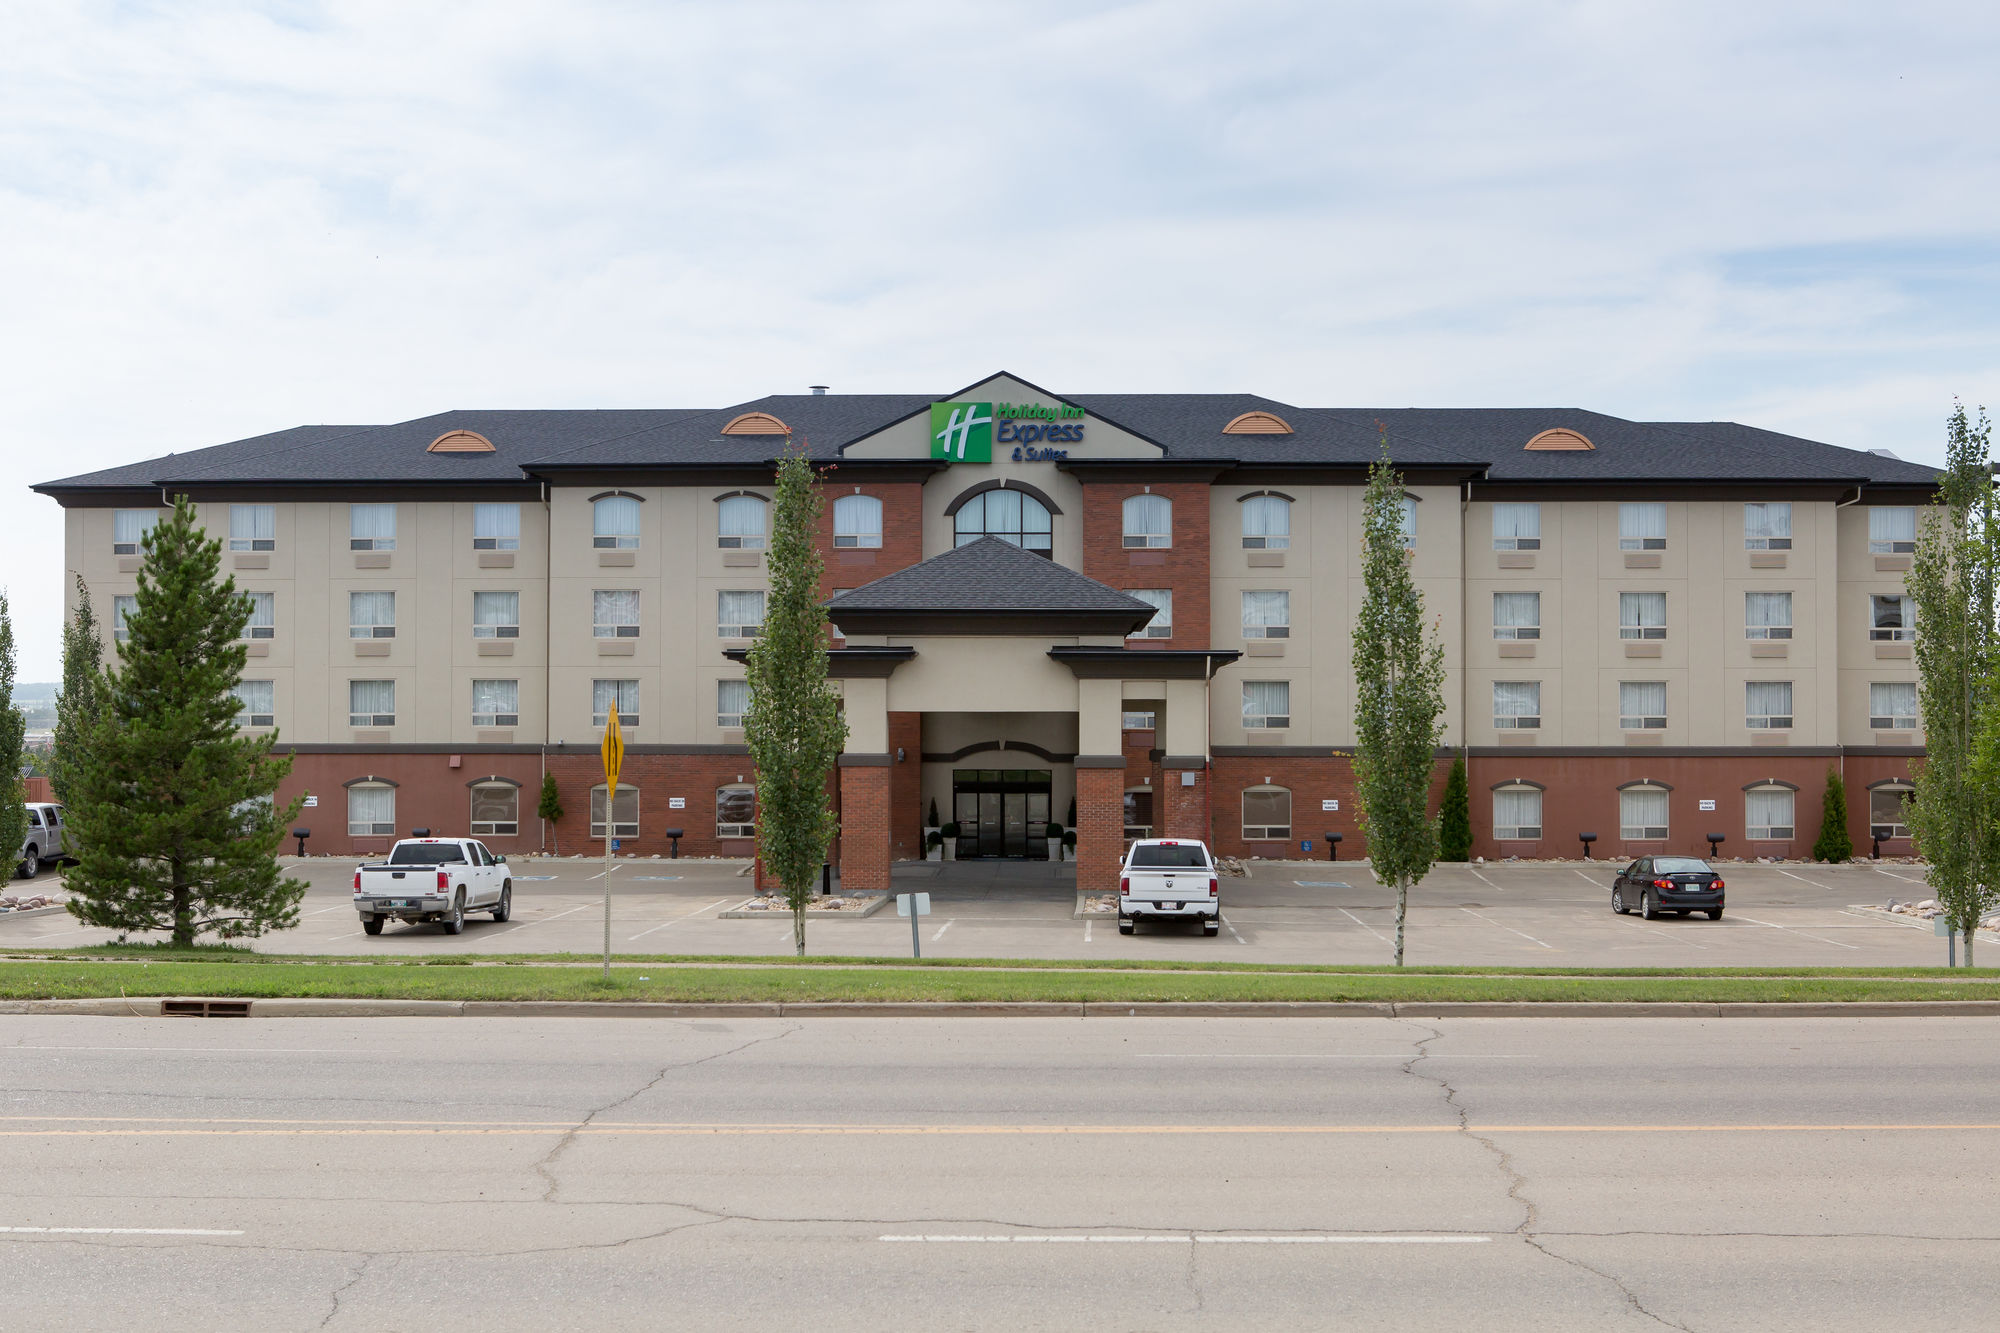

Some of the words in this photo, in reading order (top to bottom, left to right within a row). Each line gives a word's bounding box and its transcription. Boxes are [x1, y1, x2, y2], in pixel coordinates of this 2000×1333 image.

[997, 402, 1058, 422] Holiday
[1061, 402, 1085, 419] Inn
[997, 419, 1085, 448] Express
[1012, 447, 1023, 461] &
[1025, 447, 1068, 461] Suites
